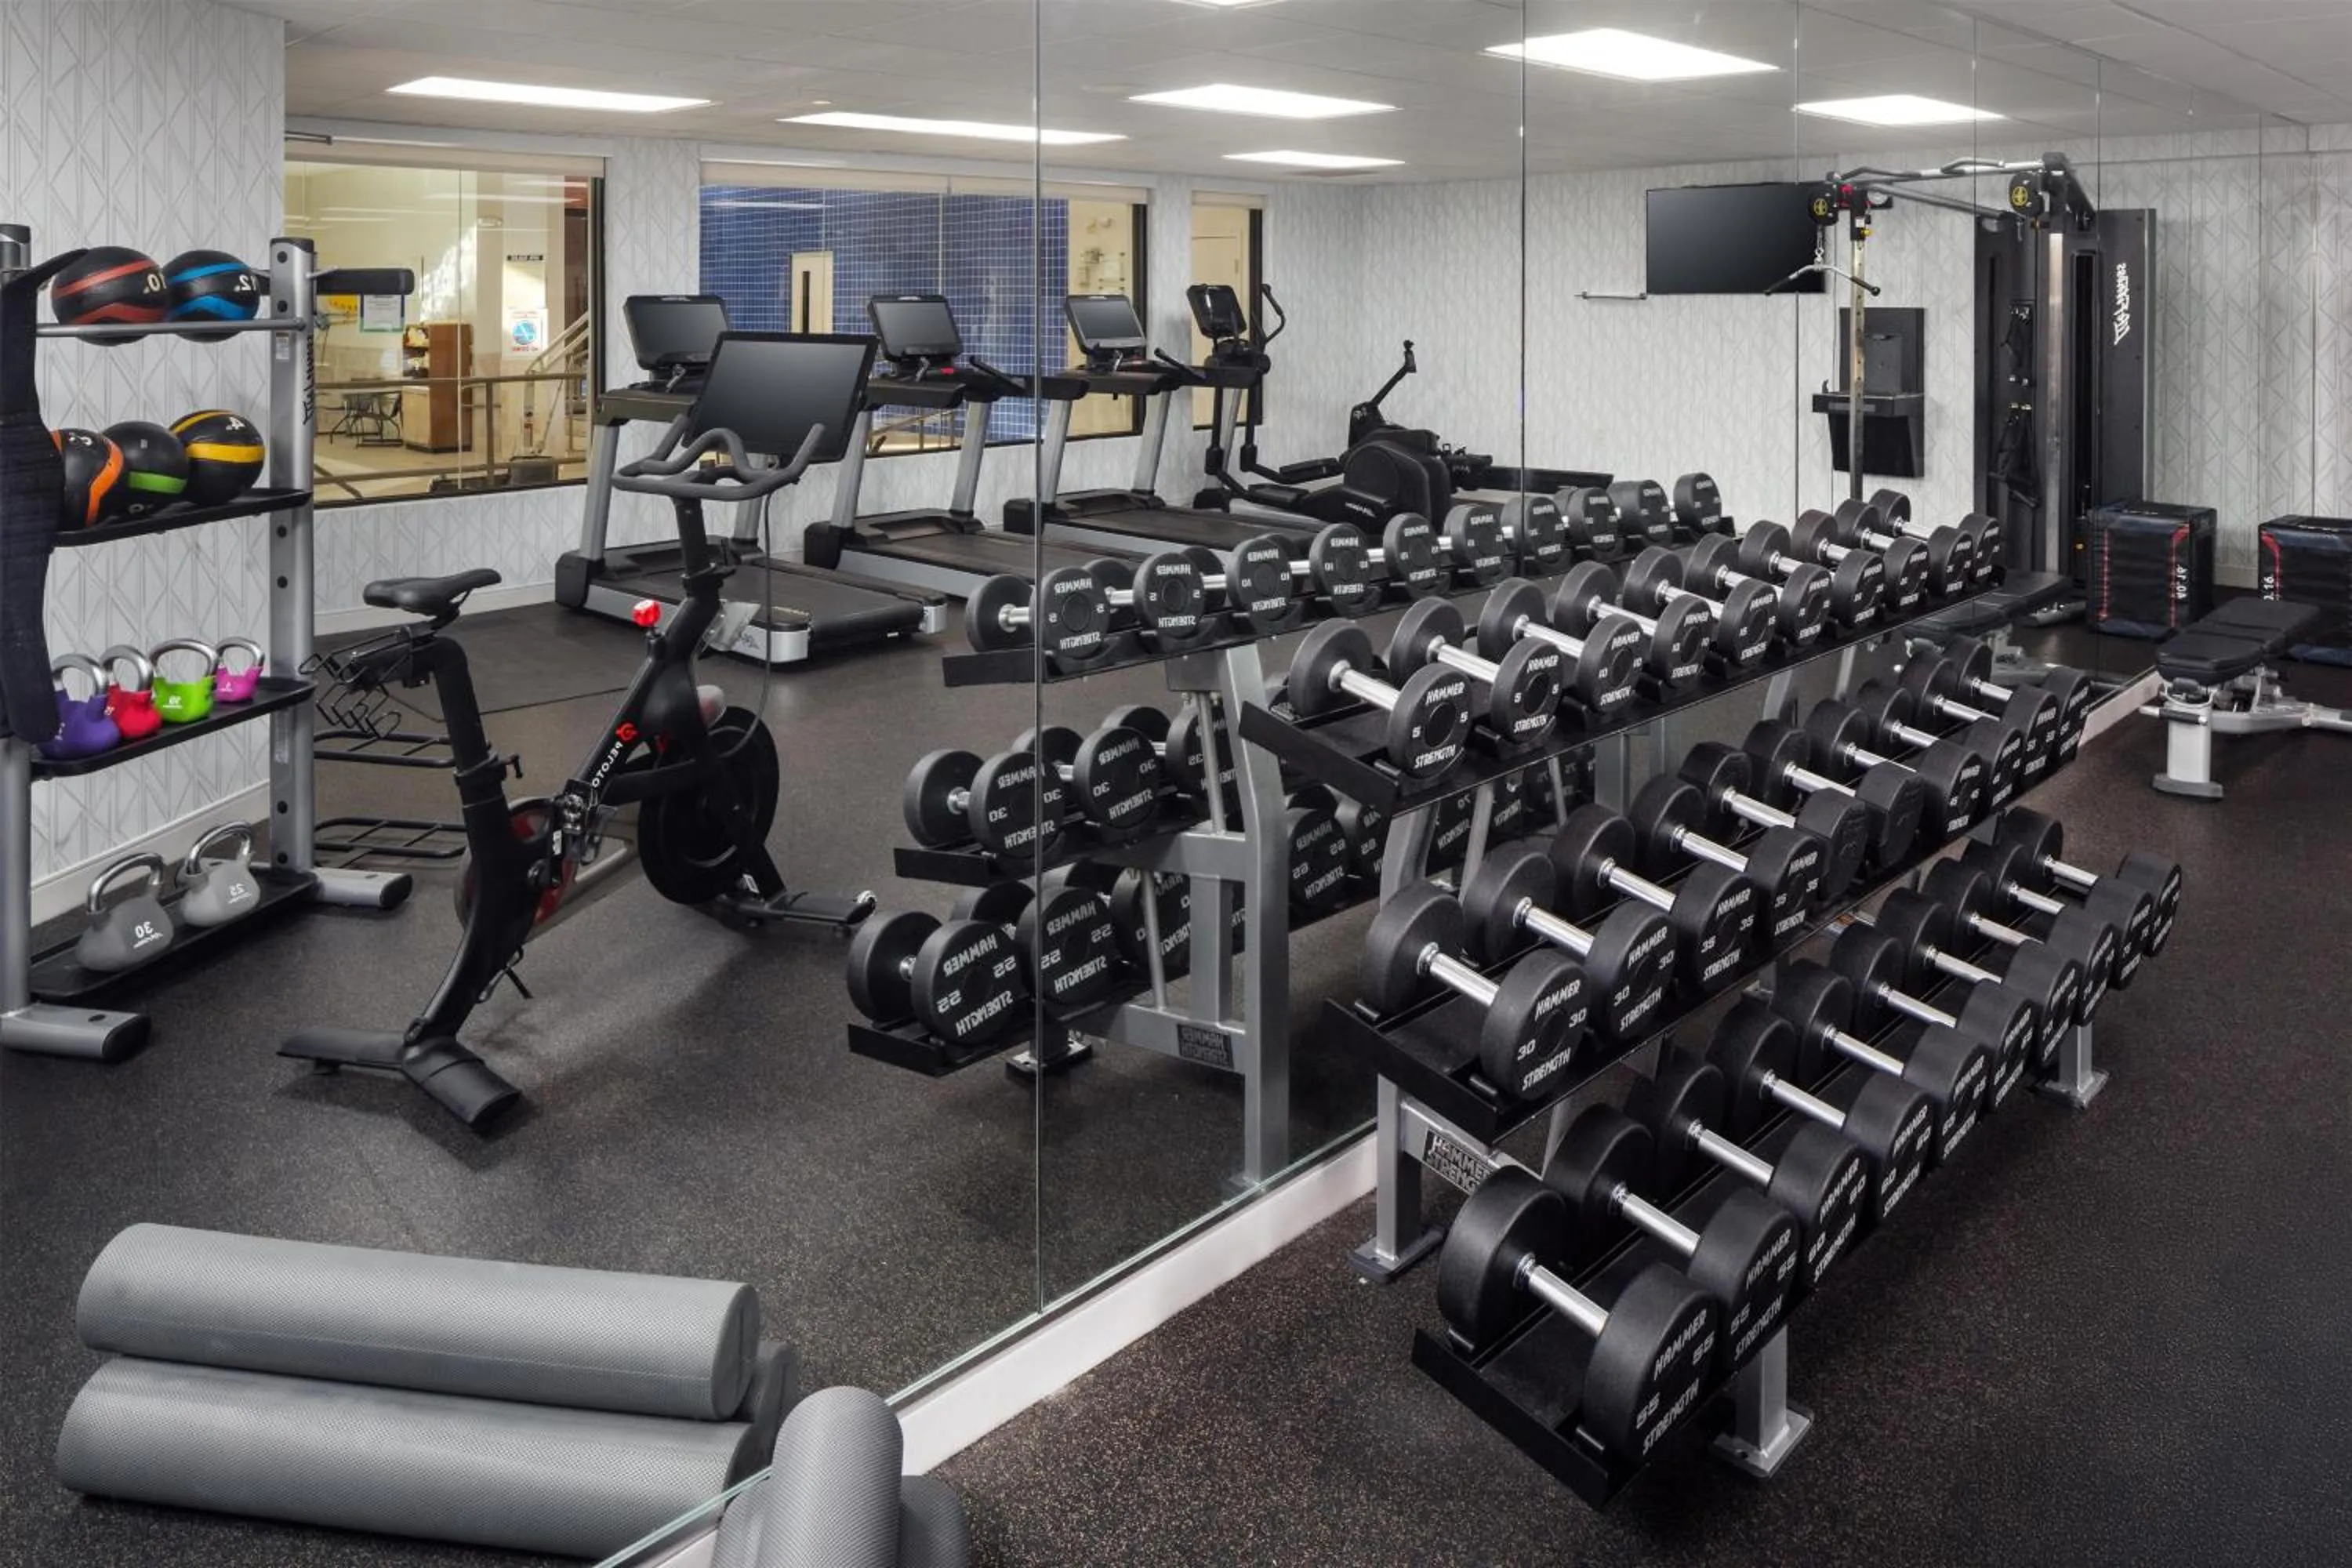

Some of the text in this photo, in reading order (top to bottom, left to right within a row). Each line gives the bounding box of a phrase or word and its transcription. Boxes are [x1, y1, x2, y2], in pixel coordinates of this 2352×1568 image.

[1425, 681, 1465, 706] HAMMER
[1412, 710, 1468, 739] 5 5
[1414, 745, 1456, 769] STRENGTH
[1627, 925, 1668, 971] HAMMER
[1535, 978, 1581, 1022] HAMMER
[1613, 949, 1675, 1007] 30 30
[1619, 987, 1662, 1033] STRENGTH
[1517, 1007, 1588, 1062] 30 30
[1522, 1047, 1572, 1091] STRENGTH
[1653, 1307, 1708, 1381] HAMMER
[1635, 1330, 1715, 1430] 55 55
[1642, 1376, 1700, 1457] STRENGTH
